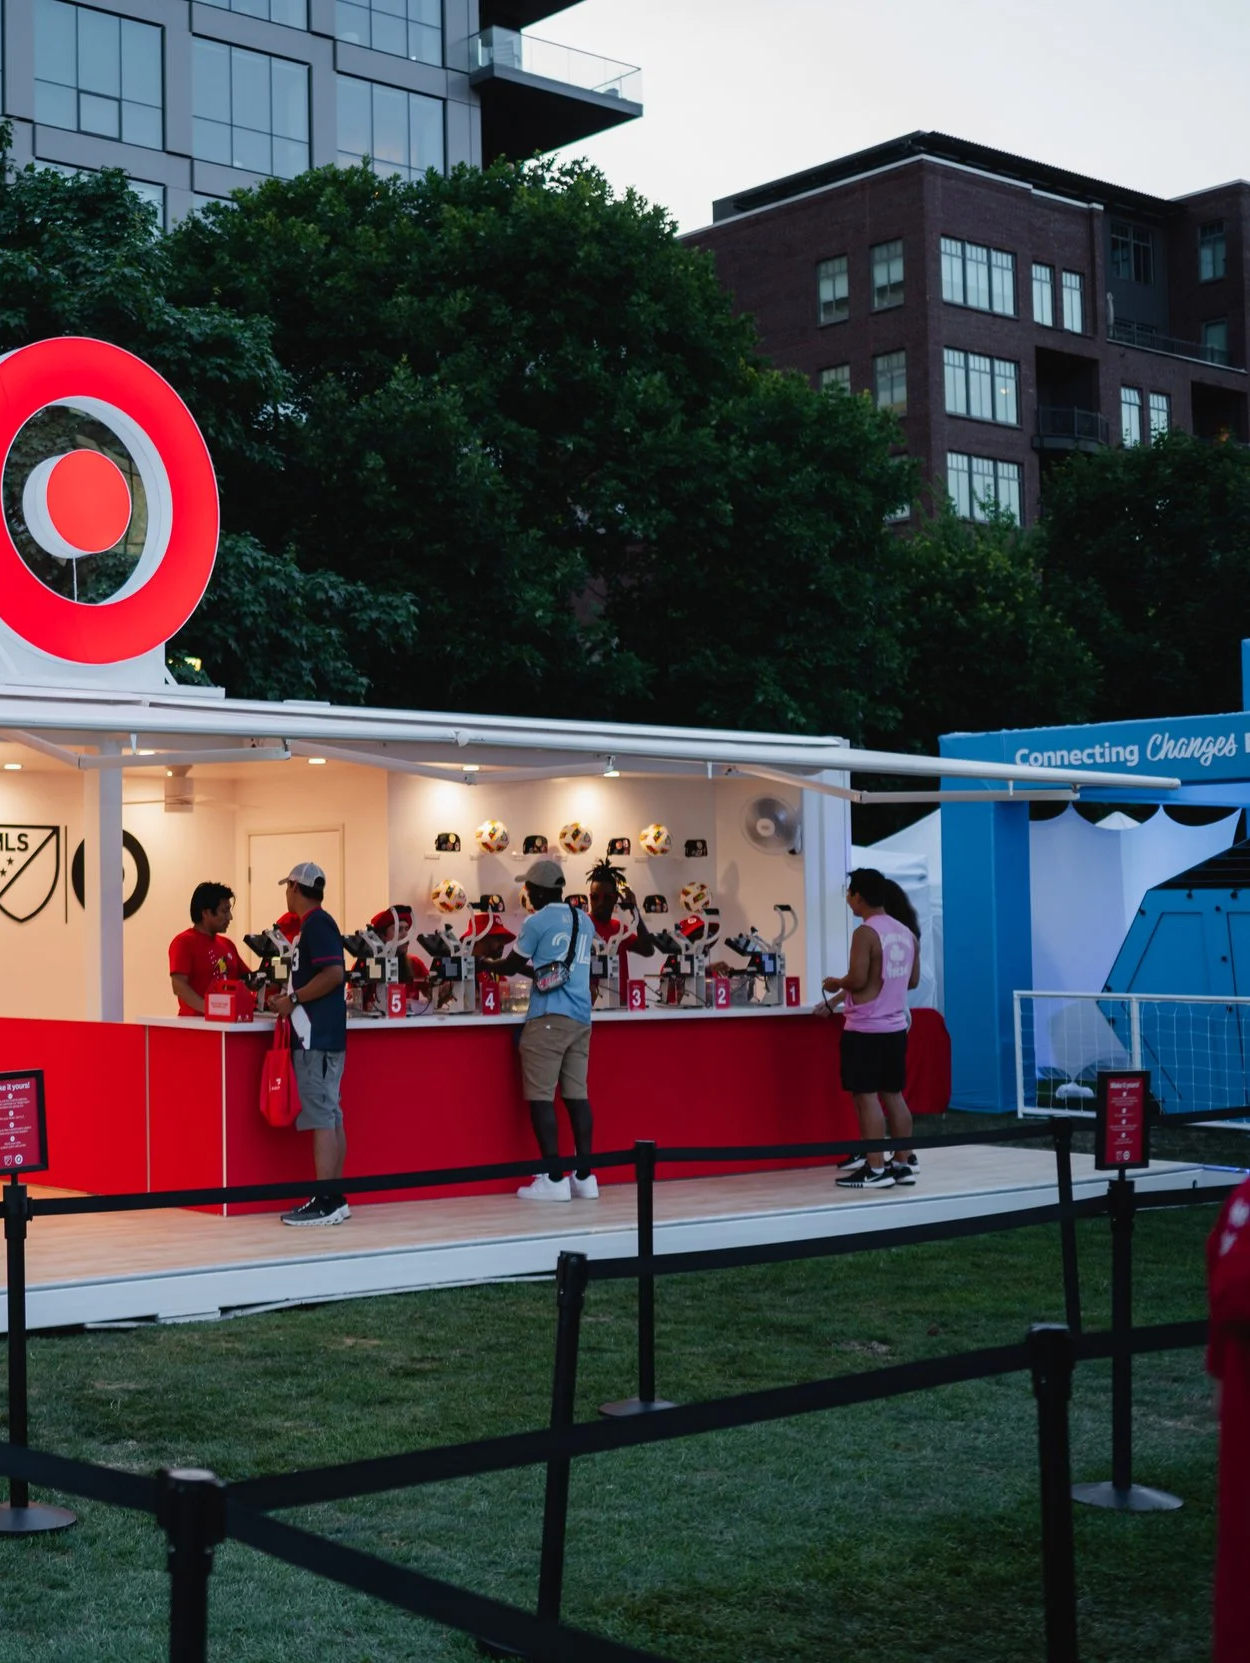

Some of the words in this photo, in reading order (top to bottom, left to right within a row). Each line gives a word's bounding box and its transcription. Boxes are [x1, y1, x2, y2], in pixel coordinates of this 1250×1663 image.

[1015, 742, 1139, 767] Connecting
[1147, 733, 1238, 766] Changes
[485, 992, 495, 1010] 4
[632, 989, 641, 1007] 3
[717, 987, 727, 1005] 2
[789, 985, 797, 1003] 1
[391, 994, 402, 1013] 5
[12, 1081, 30, 1092] yours!
